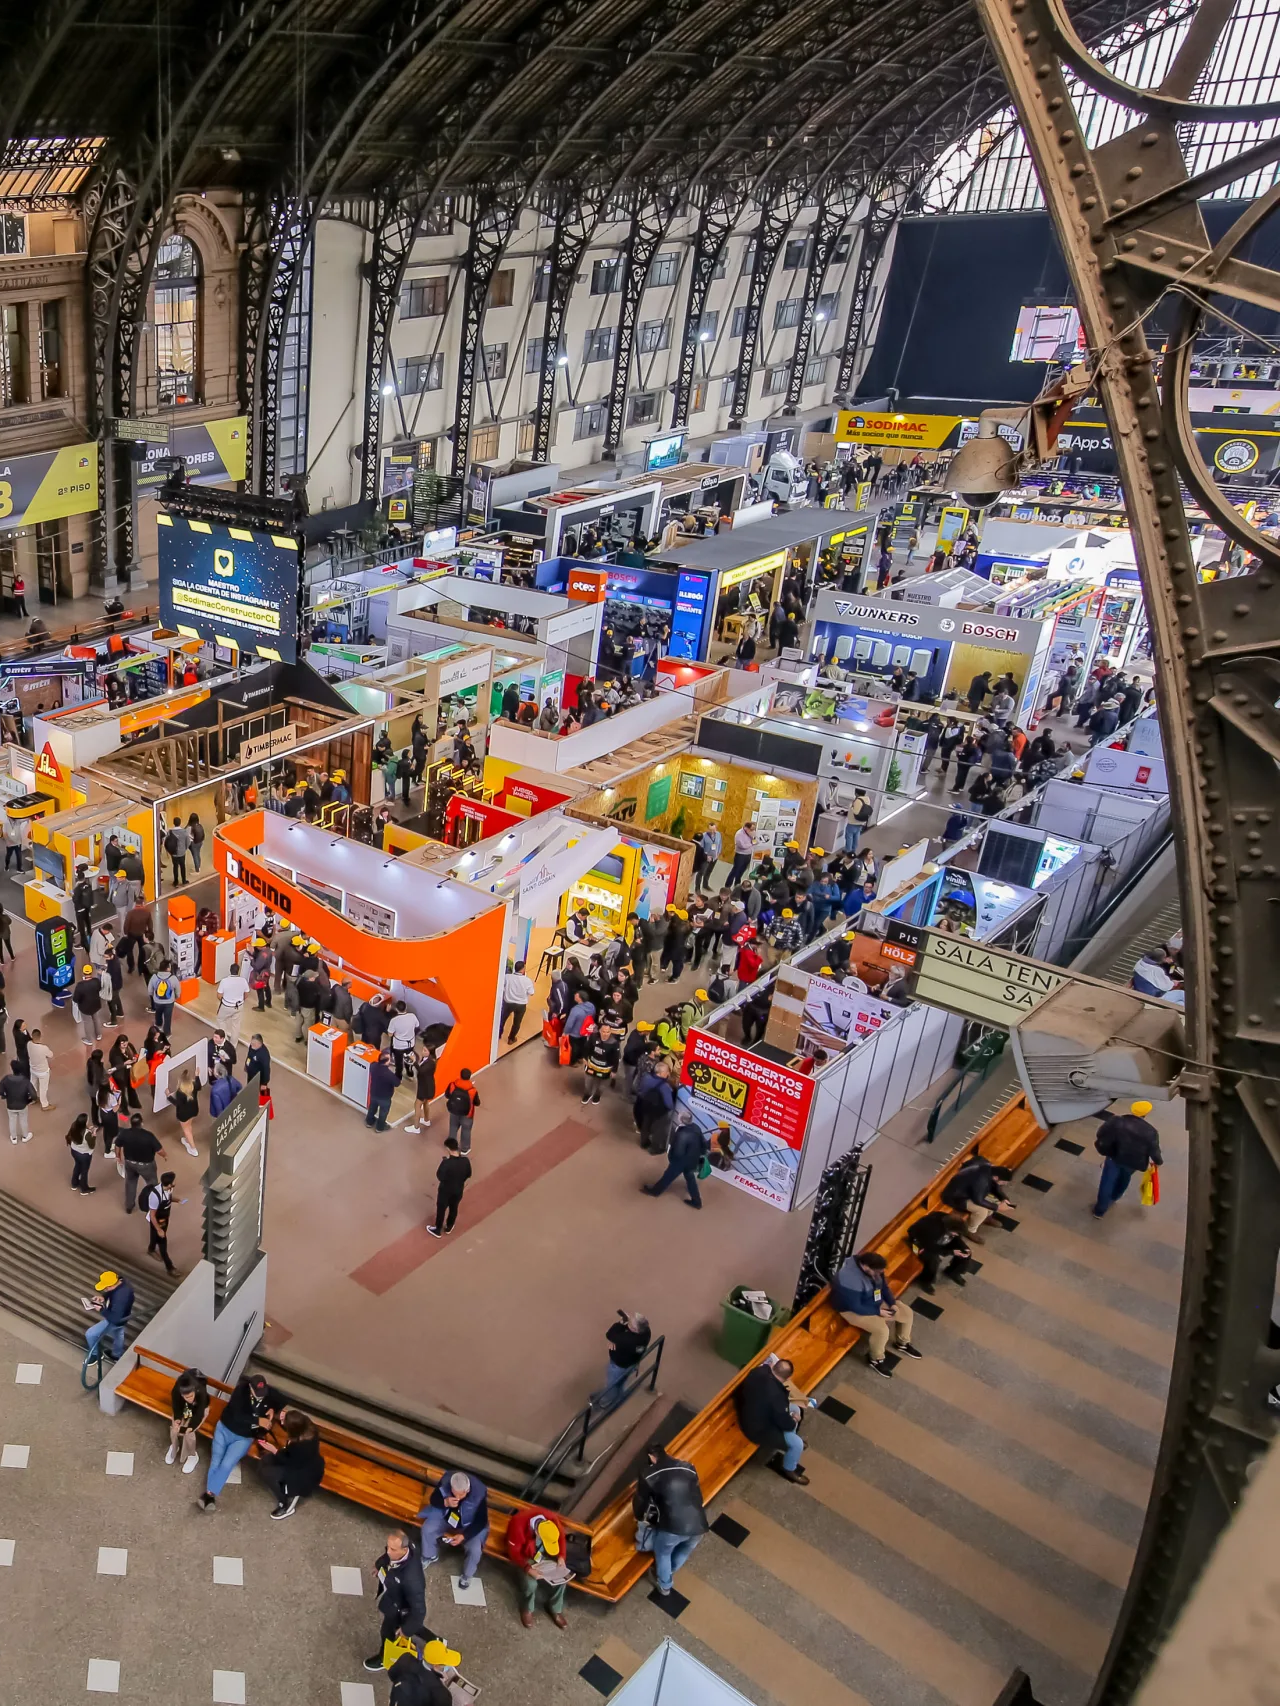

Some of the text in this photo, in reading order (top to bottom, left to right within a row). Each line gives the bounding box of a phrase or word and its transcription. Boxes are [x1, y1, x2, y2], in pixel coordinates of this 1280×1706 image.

[146, 447, 170, 460] ONA
[1071, 436, 1099, 451] App
[70, 482, 91, 494] PISO
[572, 581, 596, 593] etex
[848, 605, 1019, 641] JUNKERS BOSCH
[253, 733, 293, 754] TIMBERMAC
[37, 753, 57, 777] Sika
[226, 850, 291, 914] bticino
[899, 932, 918, 945] PIS
[883, 946, 915, 963] HÖLZ
[935, 940, 993, 973] SALA
[809, 978, 853, 1000] DURACRYL
[1002, 985, 1043, 1006] SA
[694, 1047, 801, 1100] EN POLICARBONATOS
[696, 1039, 803, 1091] SOMOS EXPERTOS
[712, 1076, 743, 1100] UV
[770, 1107, 782, 1117] mm
[771, 1100, 784, 1109] mm
[216, 1103, 242, 1136] SALA DE
[216, 1108, 247, 1147] LAS ARTES
[734, 1174, 782, 1202] FEMOGLAS
